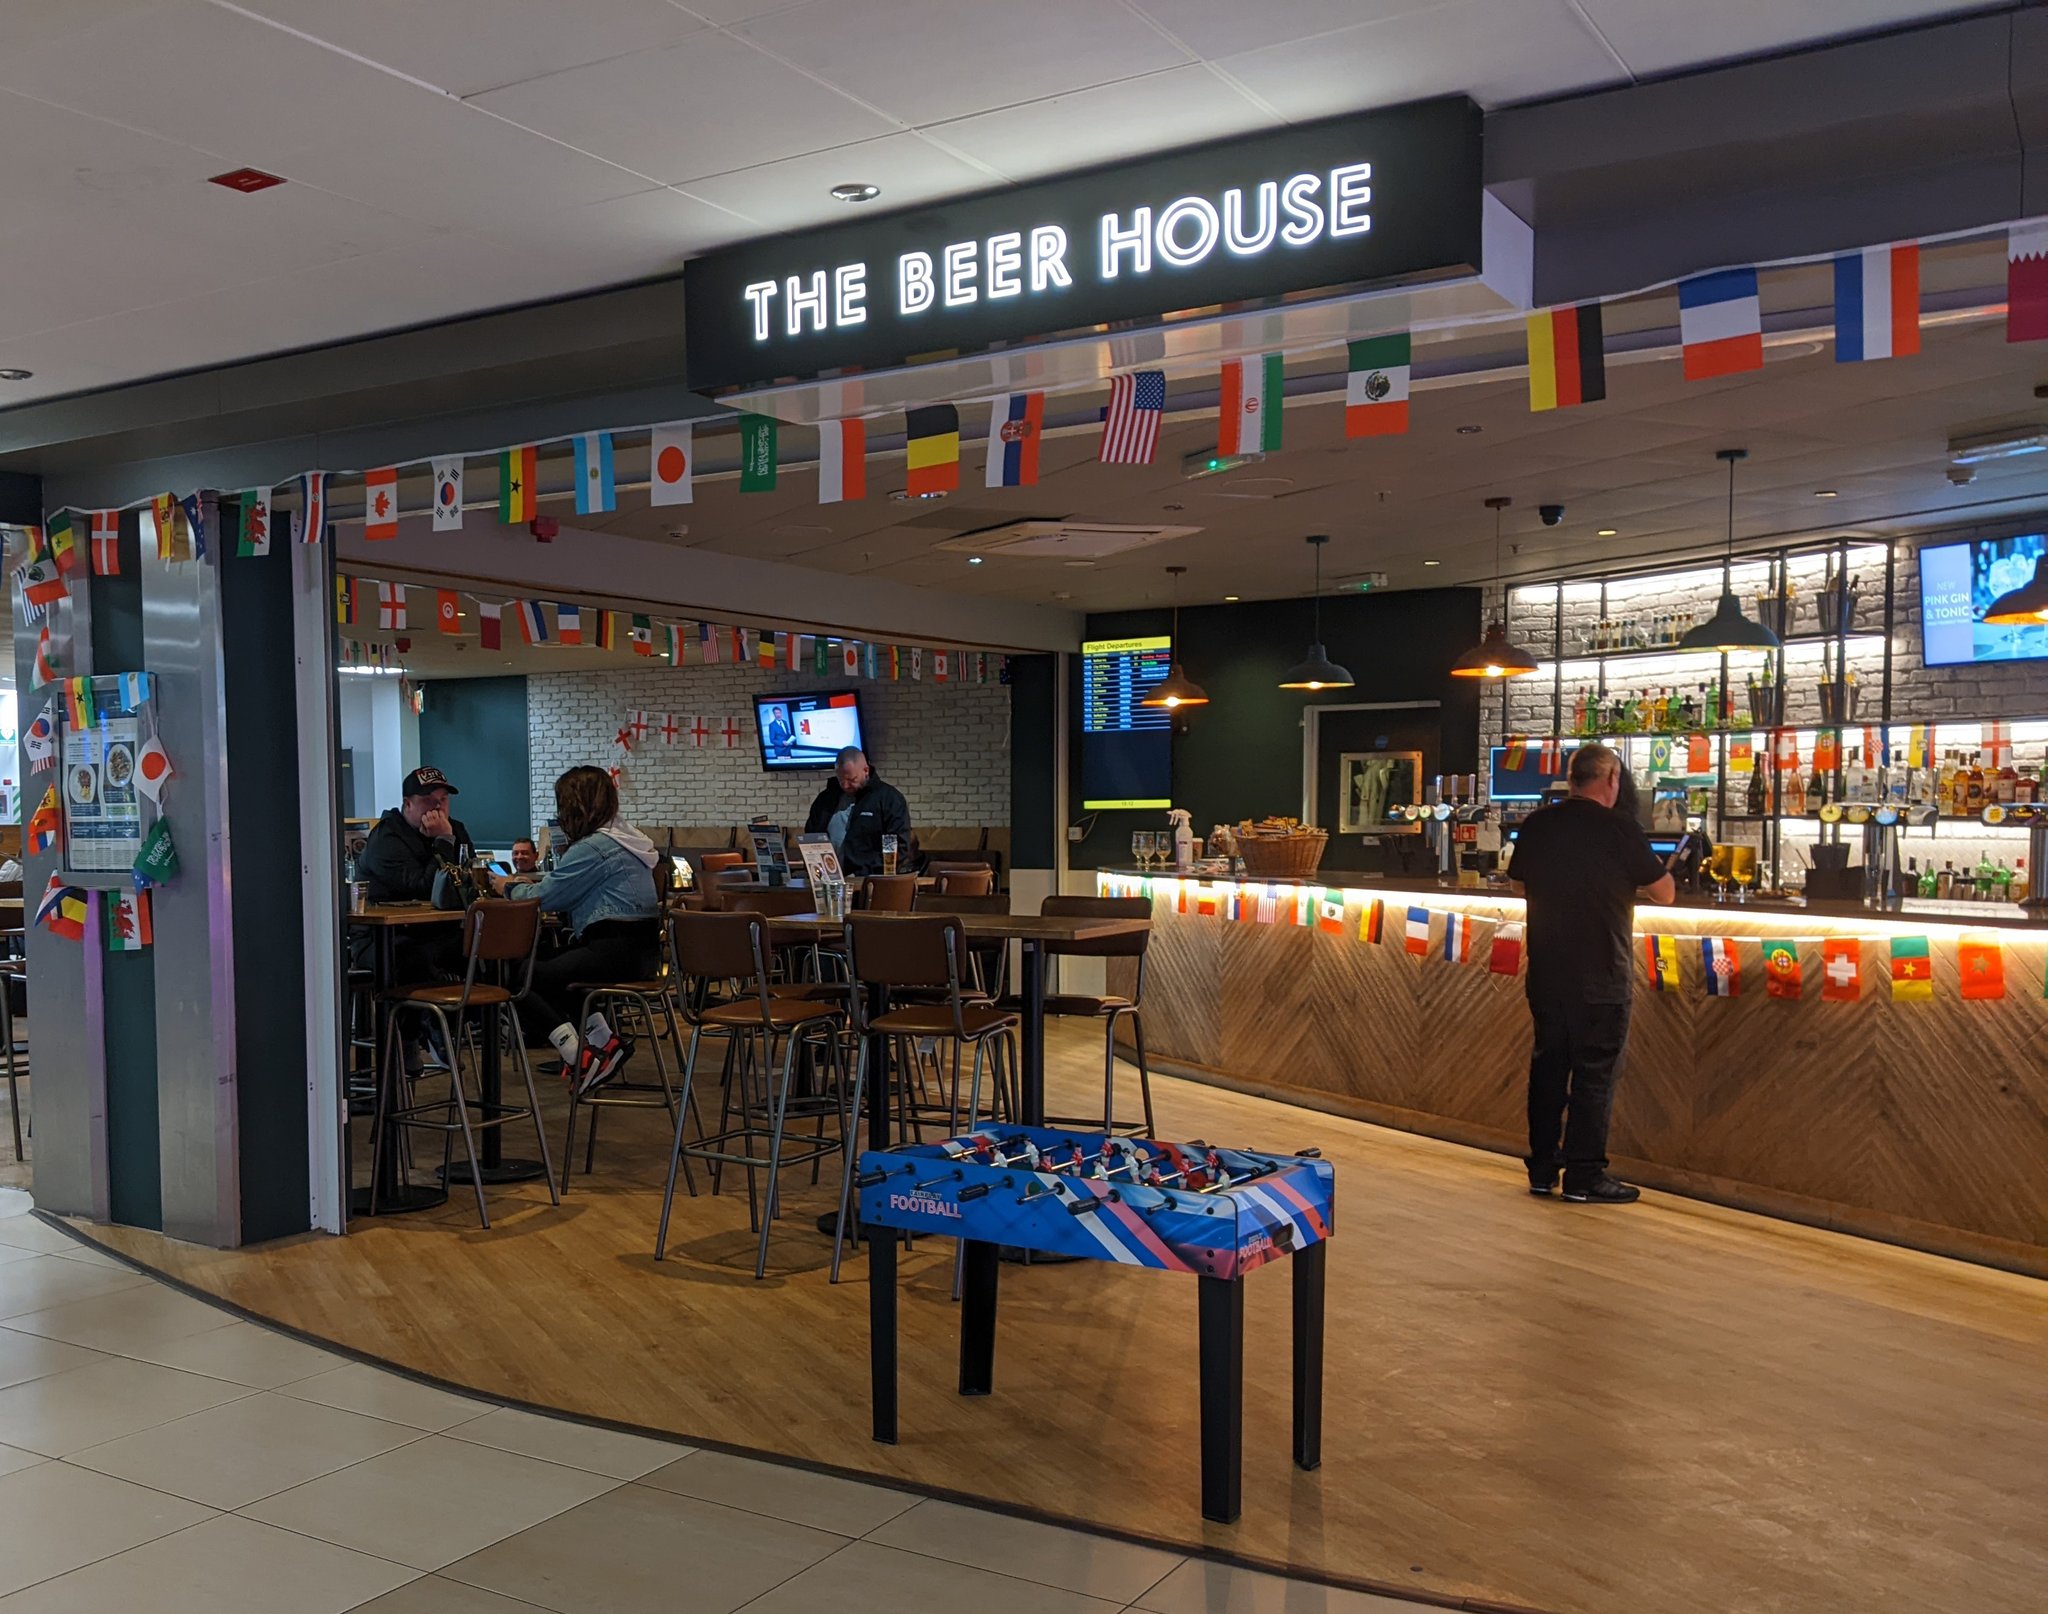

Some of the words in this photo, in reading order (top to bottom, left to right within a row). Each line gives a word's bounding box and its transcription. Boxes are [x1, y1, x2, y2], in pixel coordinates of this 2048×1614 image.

[744, 262, 867, 341] THE
[899, 225, 1073, 315] BEER
[1100, 162, 1373, 279] HOUSE
[1936, 581, 1956, 591] NEW
[1924, 594, 1949, 606] PINK
[1950, 592, 1970, 604] GIN
[1926, 609, 1935, 620] &
[1935, 605, 1970, 619] TONIC
[1086, 643, 1105, 652] Flight
[1107, 641, 1142, 650] Departures
[890, 1194, 962, 1218] FOOTBALL
